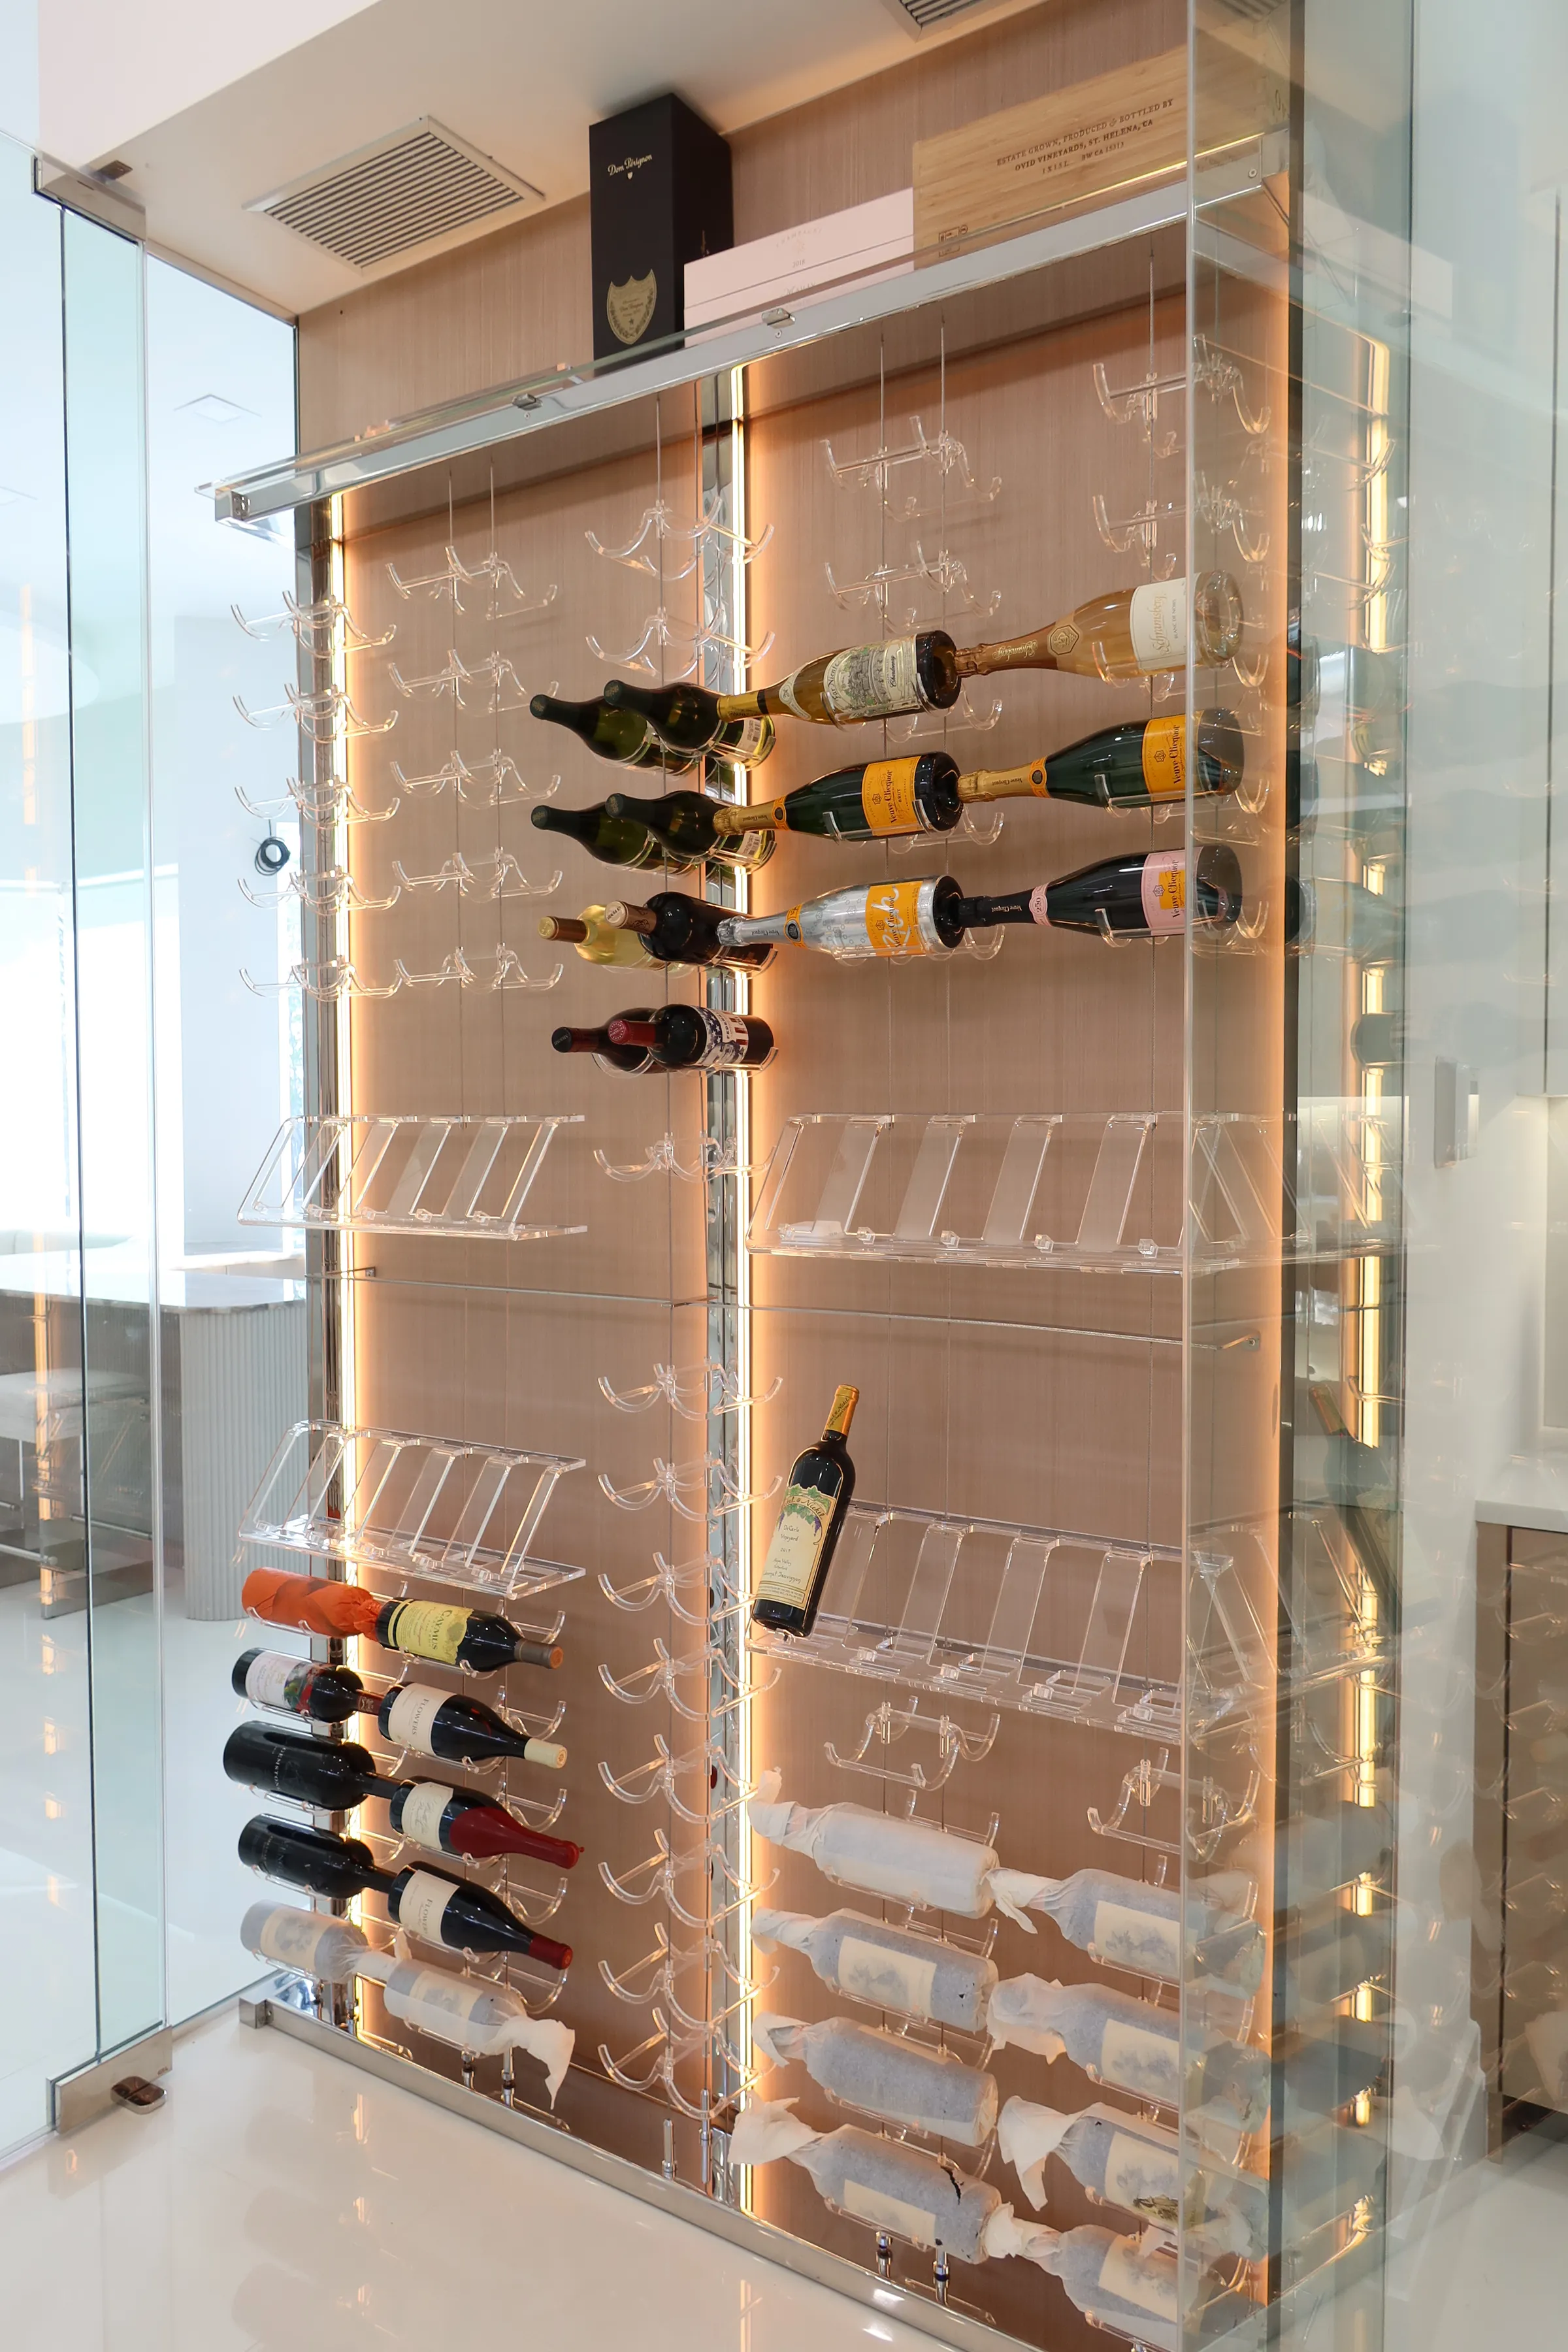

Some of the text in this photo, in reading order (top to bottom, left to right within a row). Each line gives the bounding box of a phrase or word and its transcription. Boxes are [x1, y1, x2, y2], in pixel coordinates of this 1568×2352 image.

[996, 150, 1027, 166] ESTATE
[1028, 138, 1061, 154] GROWN,
[1063, 122, 1107, 142] PRODUCED
[1119, 103, 1160, 123] BOTTLED
[1162, 99, 1174, 108] BY
[1015, 119, 1153, 171] OVID VINEYARDS, ST. HELENA, CA
[607, 154, 653, 176] Dom Pérignon
[1147, 593, 1171, 655] Schramsberg
[828, 662, 841, 702] Far Niente
[1169, 724, 1181, 759] Clicquot
[884, 770, 897, 824] Veuve Clicquot
[1168, 860, 1181, 918] Veuve Clicquot
[892, 929, 902, 947] Veuve
[801, 1499, 826, 1520] Nickel
[781, 1533, 799, 1543] Vineyard
[778, 1571, 802, 1585] Sauvignon
[782, 1558, 792, 1567] Valley
[433, 1609, 453, 1650] CAYMUS
[412, 1699, 429, 1735] FLOWERS
